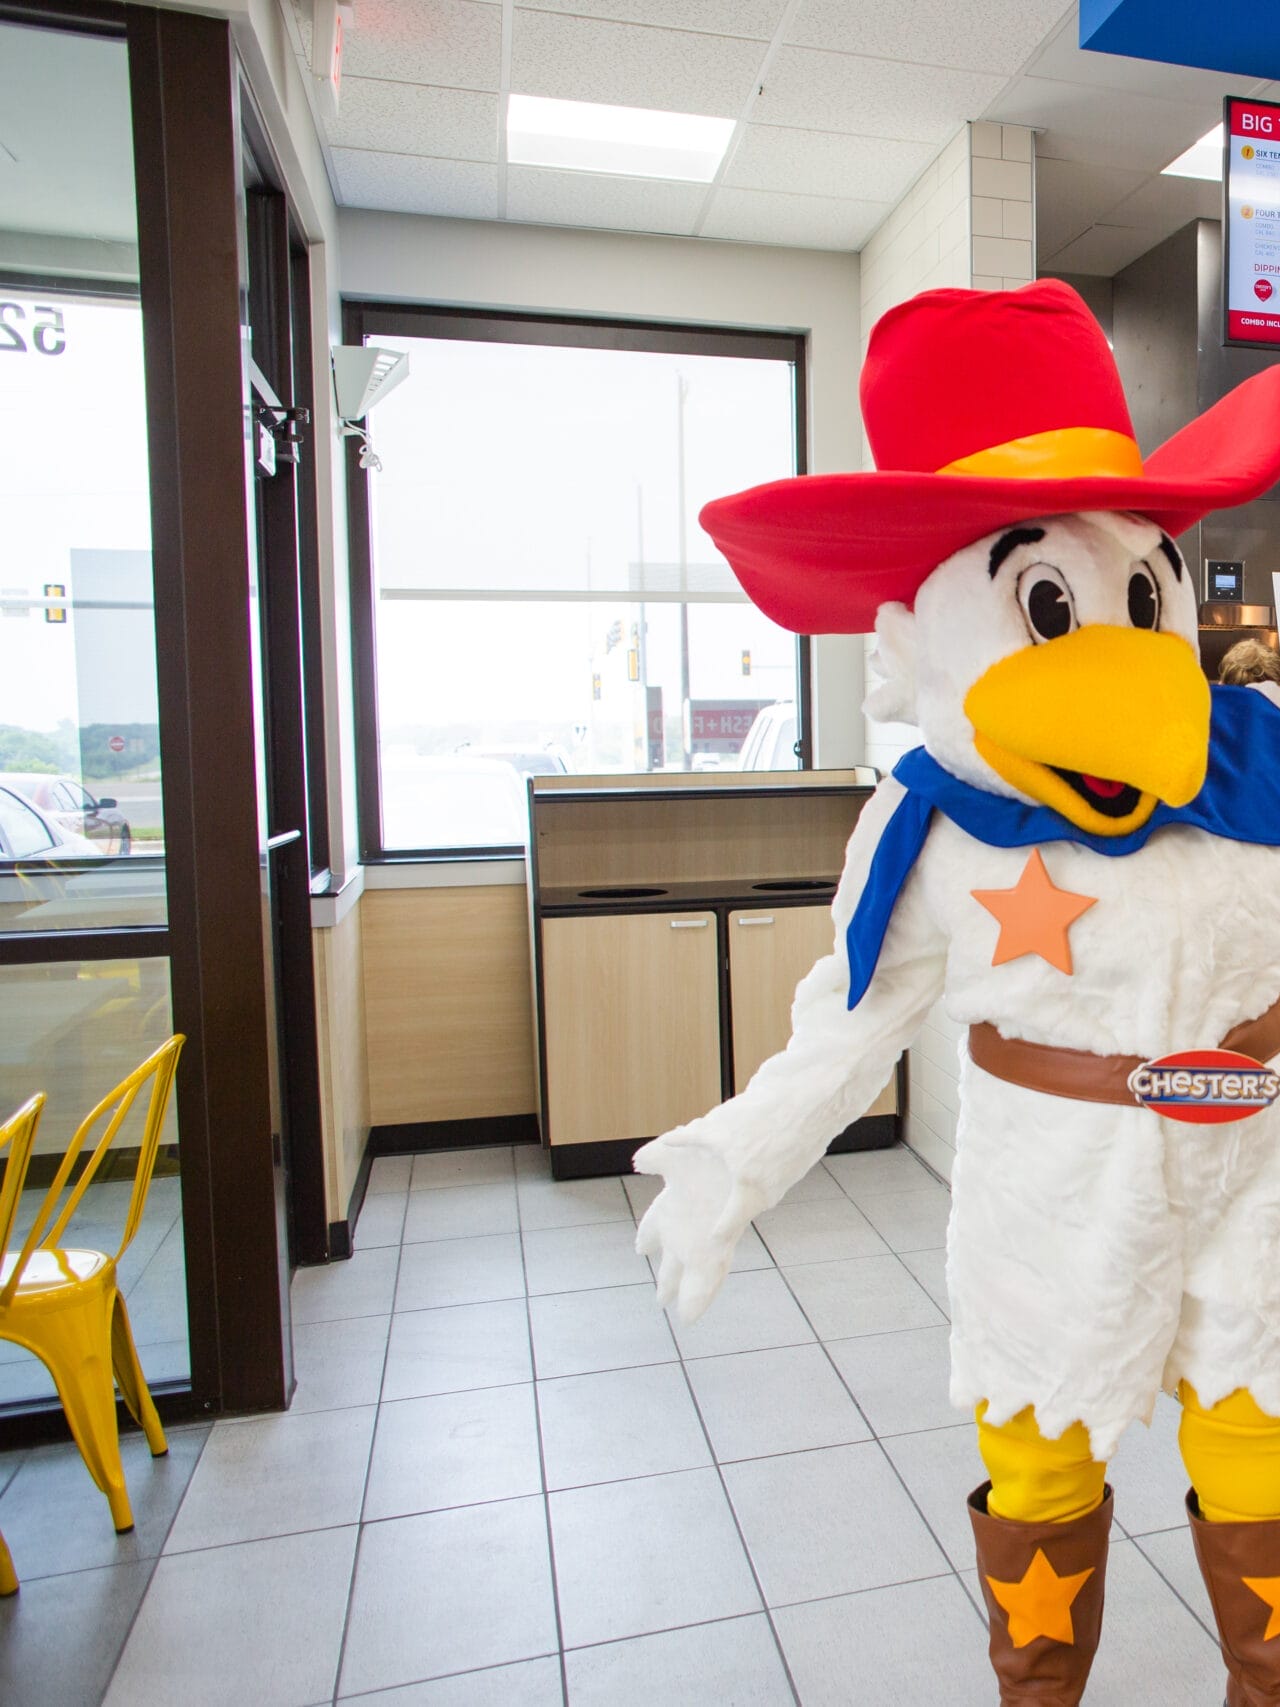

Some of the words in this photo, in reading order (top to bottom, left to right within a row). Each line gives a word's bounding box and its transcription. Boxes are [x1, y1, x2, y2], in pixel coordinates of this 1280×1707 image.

[1241, 113, 1273, 133] BIG
[1255, 149, 1268, 158] SIX
[1255, 208, 1276, 218] FOUR
[1240, 317, 1265, 327] COMBO
